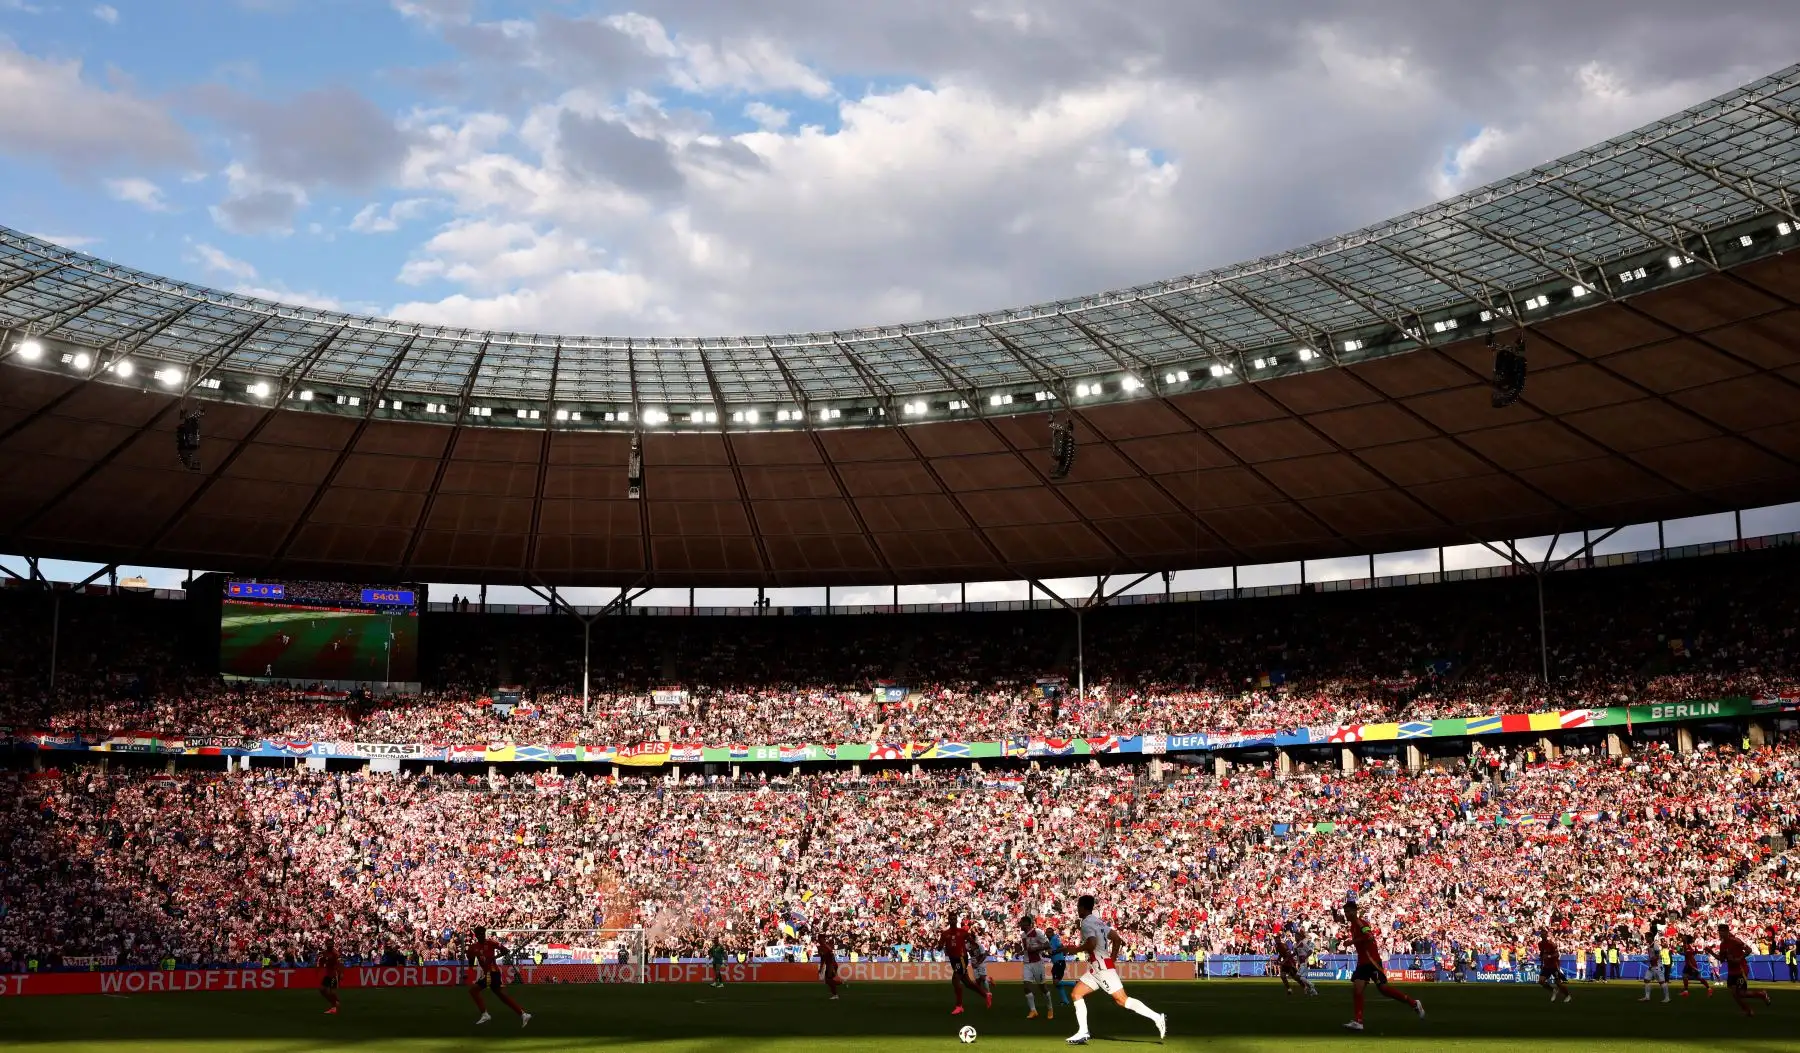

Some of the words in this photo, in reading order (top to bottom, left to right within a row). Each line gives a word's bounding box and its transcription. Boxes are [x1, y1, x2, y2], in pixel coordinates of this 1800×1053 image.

[373, 592, 400, 601] 54:01
[1651, 702, 1719, 719] BERLIN
[1172, 735, 1206, 748] UEFA
[356, 744, 421, 754] KITASI
[756, 748, 817, 759] BEN
[359, 966, 538, 985] WORLDFST
[819, 963, 954, 980] ORLDFIRS
[1405, 970, 1434, 982] AliExpres
[1476, 971, 1514, 982] Booking.com
[1526, 971, 1540, 983] Alip
[101, 969, 295, 993] WORLDFIRST
